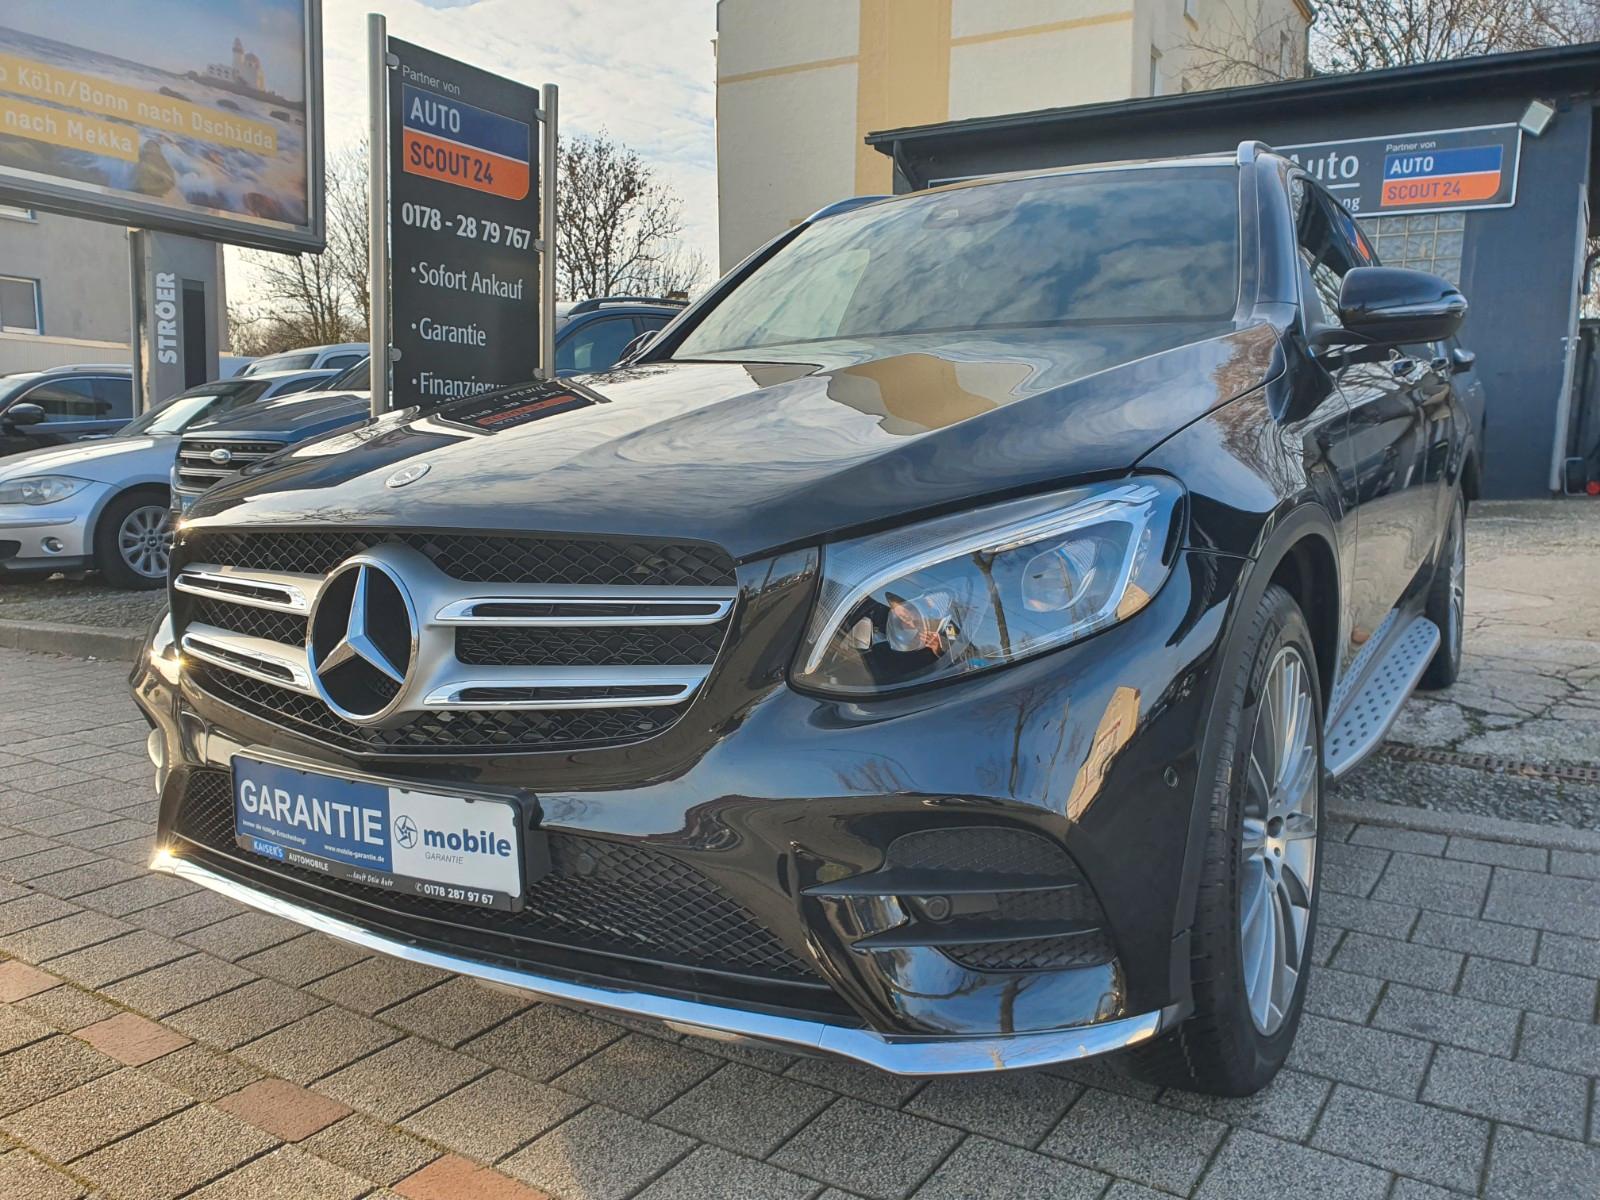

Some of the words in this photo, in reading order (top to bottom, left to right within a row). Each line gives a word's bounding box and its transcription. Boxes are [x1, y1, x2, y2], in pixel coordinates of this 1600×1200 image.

[402, 64, 440, 88] Partner
[443, 82, 461, 95] von
[18, 65, 128, 112] Köln/Bonn
[138, 101, 184, 127] nach
[192, 112, 273, 149] Dschidda
[410, 97, 461, 133] AUTO
[5, 110, 57, 135] nach
[67, 120, 133, 153] Mekka
[1386, 143, 1417, 152] Partner
[1420, 141, 1436, 149] von
[1290, 152, 1359, 179] uto
[1390, 157, 1434, 175] AUTO
[402, 202, 441, 231] 0178
[456, 215, 477, 239] 28
[481, 221, 500, 243] 79
[504, 226, 531, 249] 767
[418, 261, 467, 291] Sofort
[471, 272, 523, 300] Ankauf
[155, 272, 177, 364] STRÖER
[419, 318, 487, 346] Garantie
[240, 779, 385, 845] GARANTIE
[423, 828, 512, 857] mobile
[288, 852, 329, 872] AUTOMOBILE
[424, 851, 464, 865] GARANTIE
[423, 884, 446, 897] 0178
[447, 888, 465, 900] 287
[467, 891, 479, 902] 97
[481, 894, 494, 905] 67
